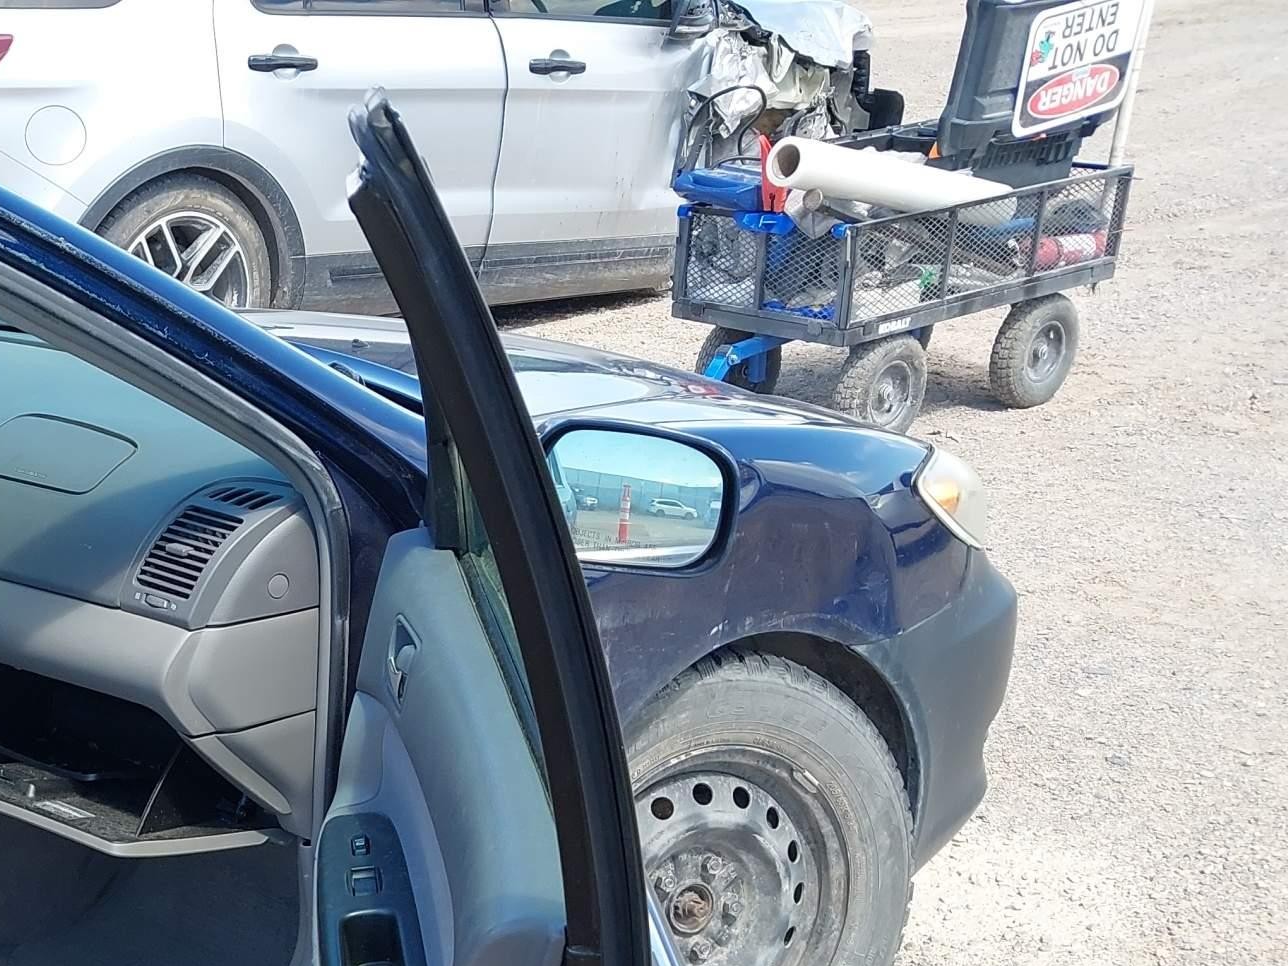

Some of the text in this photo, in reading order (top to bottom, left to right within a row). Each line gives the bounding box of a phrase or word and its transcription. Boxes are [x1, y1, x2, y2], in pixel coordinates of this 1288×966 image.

[1062, 2, 1120, 39] ENTER
[1048, 28, 1120, 71] DO NOT
[1037, 71, 1111, 111] DANGER
